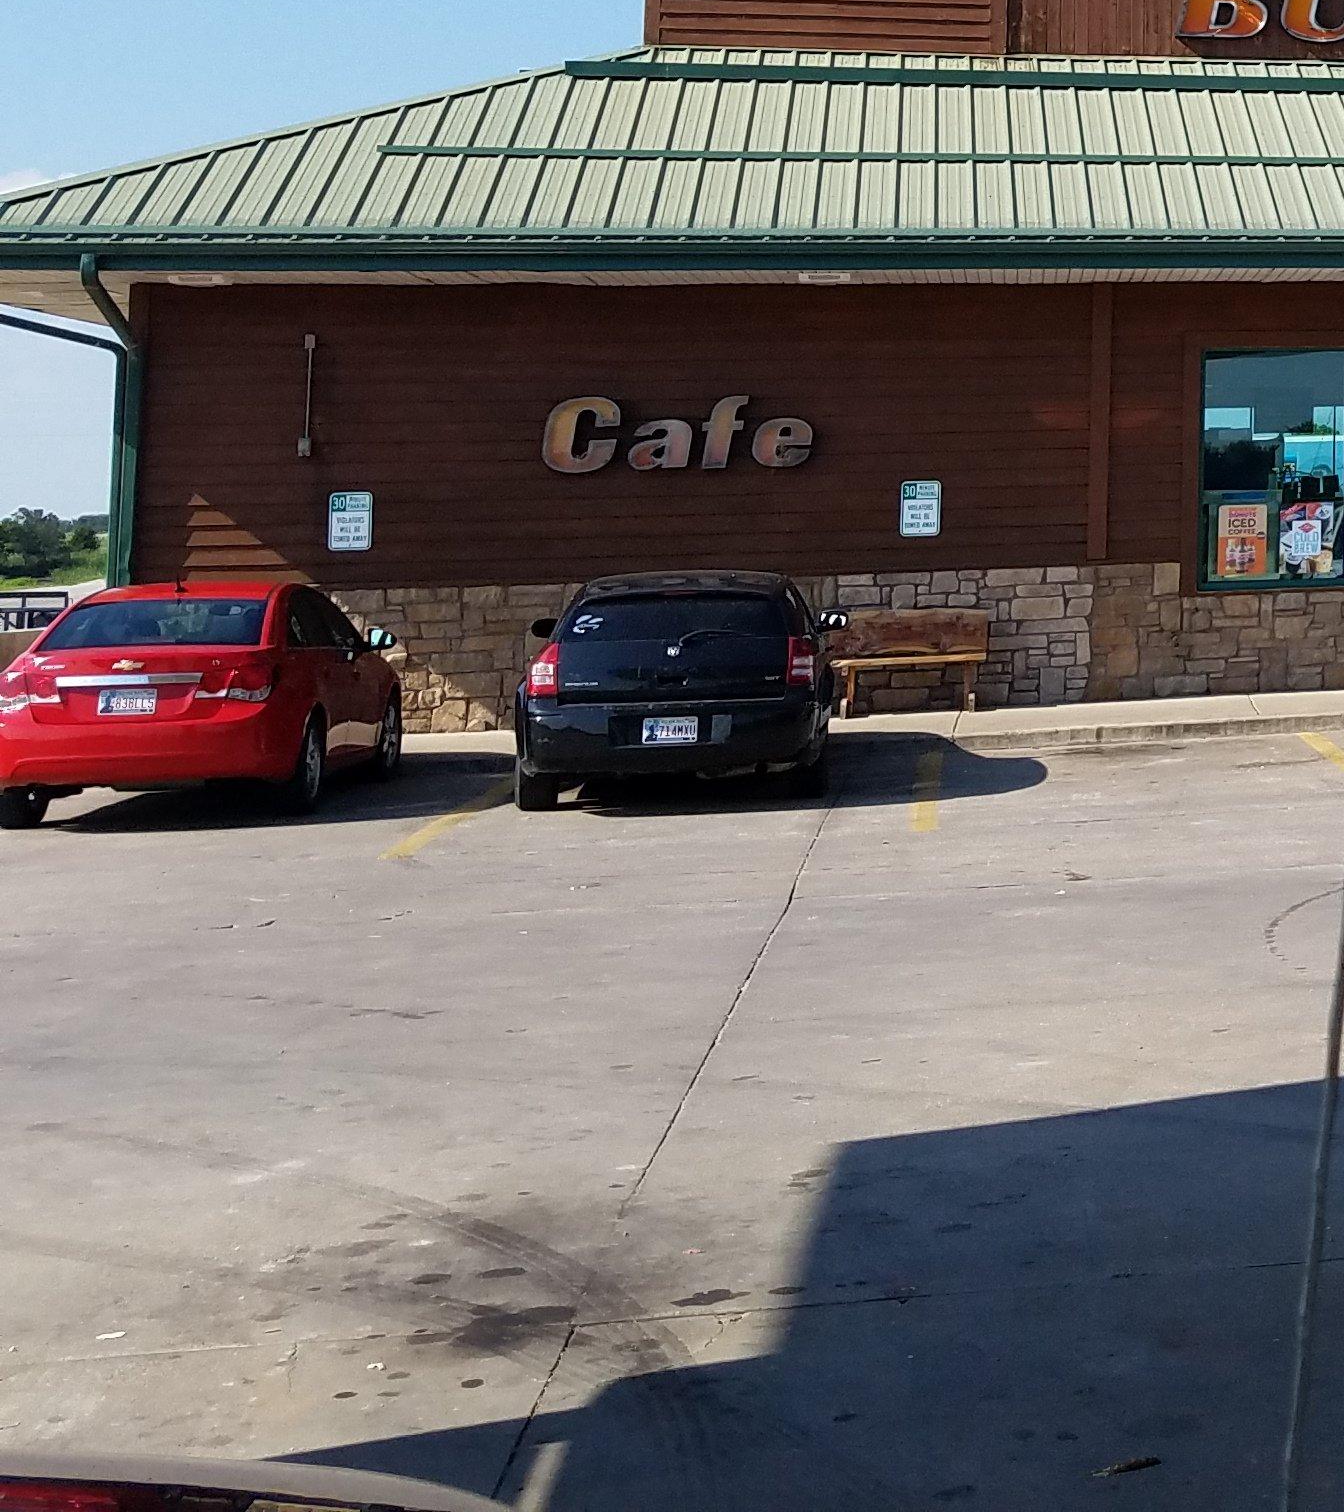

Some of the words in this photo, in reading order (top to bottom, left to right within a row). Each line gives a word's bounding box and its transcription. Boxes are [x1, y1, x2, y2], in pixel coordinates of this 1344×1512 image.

[541, 395, 814, 474] Cafe
[904, 485, 916, 497] 30
[332, 497, 346, 510] 30
[1228, 518, 1256, 528] ICED
[1294, 532, 1319, 542] COLD
[1294, 542, 1319, 554] BREW
